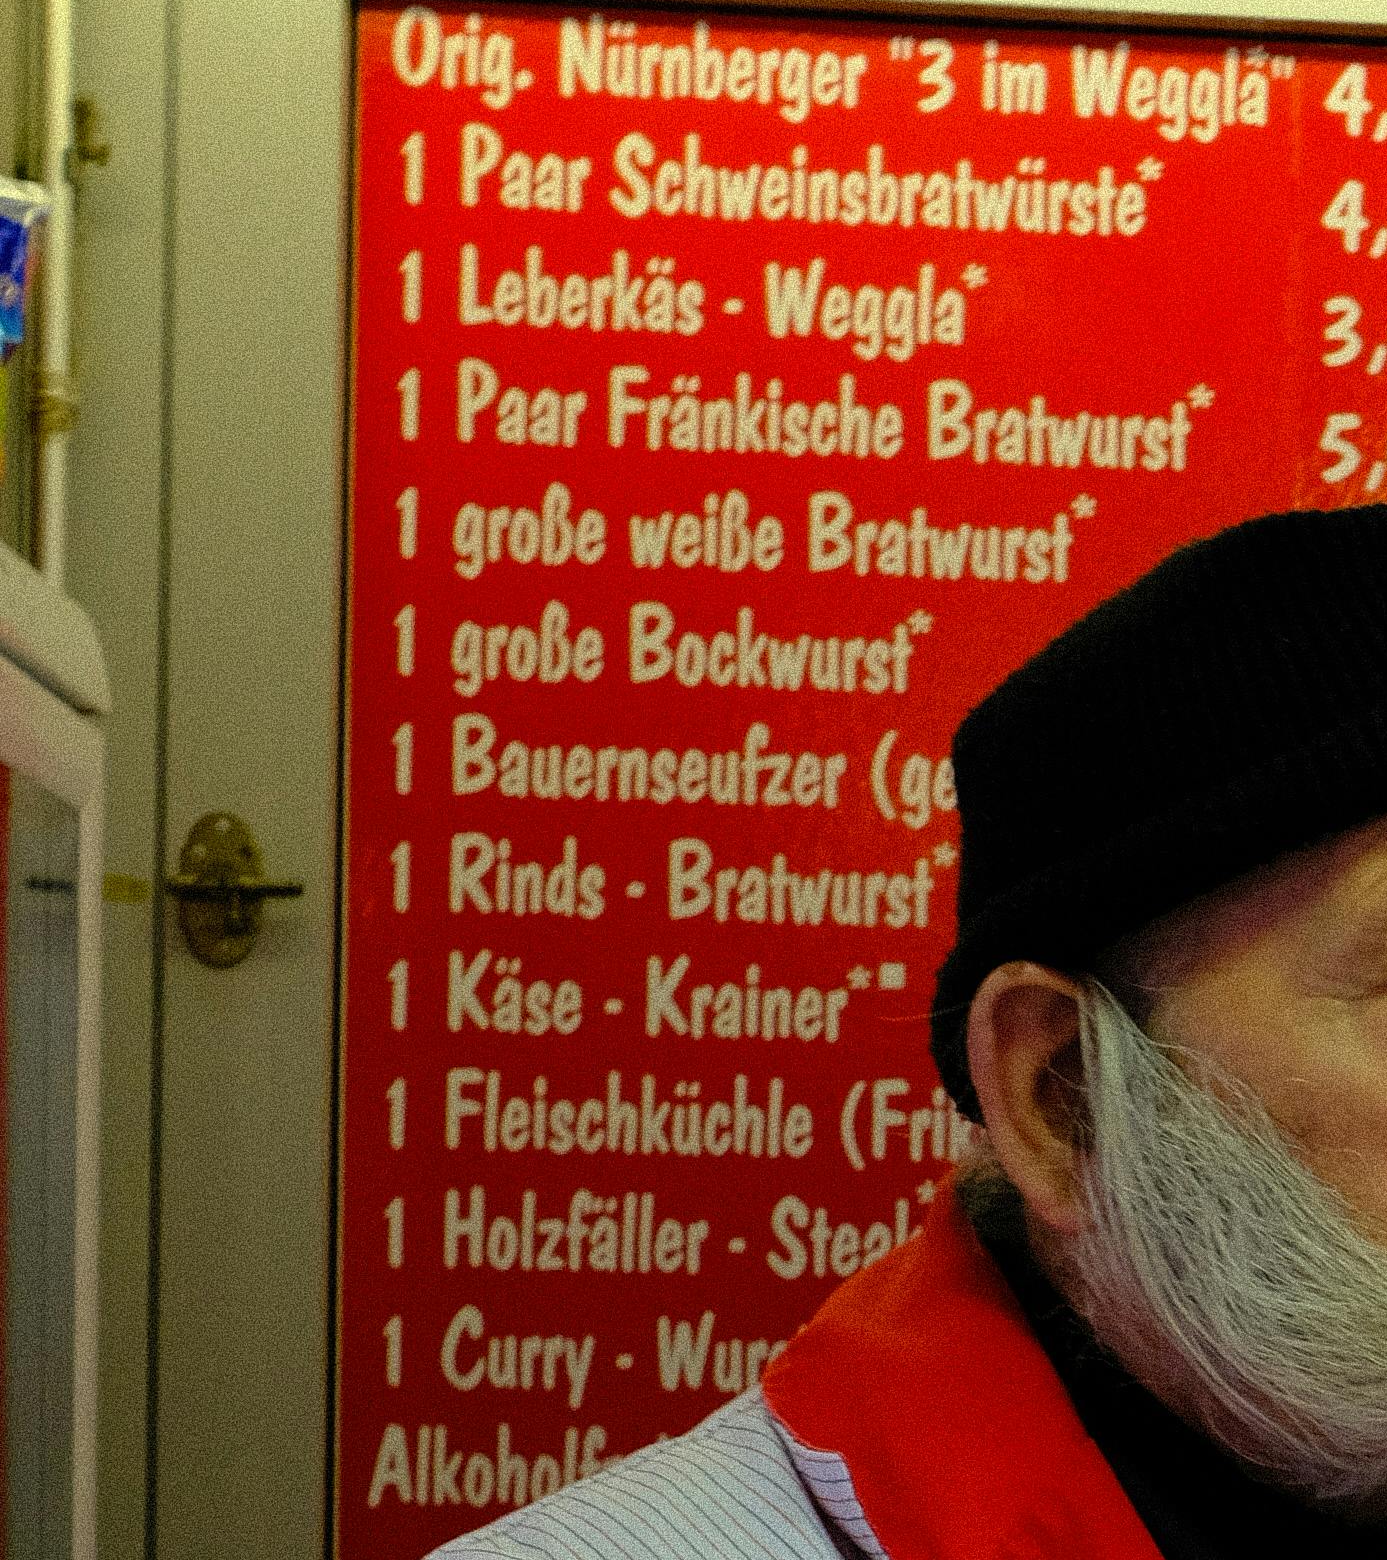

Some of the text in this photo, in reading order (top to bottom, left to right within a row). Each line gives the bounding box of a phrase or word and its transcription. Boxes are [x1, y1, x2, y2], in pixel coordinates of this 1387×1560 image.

[390, 4, 534, 110] Orig.
[558, 12, 869, 124] Nürnberger
[980, 39, 1049, 115] im
[399, 132, 424, 205] 1
[460, 121, 592, 212] Paar
[397, 250, 422, 323] 1
[458, 243, 705, 336] Leberkäs
[395, 368, 420, 440] 1
[457, 357, 587, 447] Paar
[608, 364, 904, 459] Fränkische
[394, 487, 418, 558] 1
[452, 482, 607, 580] große
[629, 489, 784, 572] weiße
[391, 605, 415, 676] 1
[450, 600, 604, 697] große
[390, 712, 960, 830] 1 Bauernseufzer (ge
[387, 841, 411, 912] 1
[448, 831, 606, 920] Rinds
[385, 959, 409, 1030] 1
[446, 949, 583, 1036] Käse
[383, 1078, 407, 1149] 1
[444, 1066, 814, 1158] Fleischküchle
[381, 1197, 404, 1268] 1
[443, 1185, 710, 1274] Holzfäller
[380, 1315, 403, 1386] 1
[440, 1304, 596, 1409] Curry
